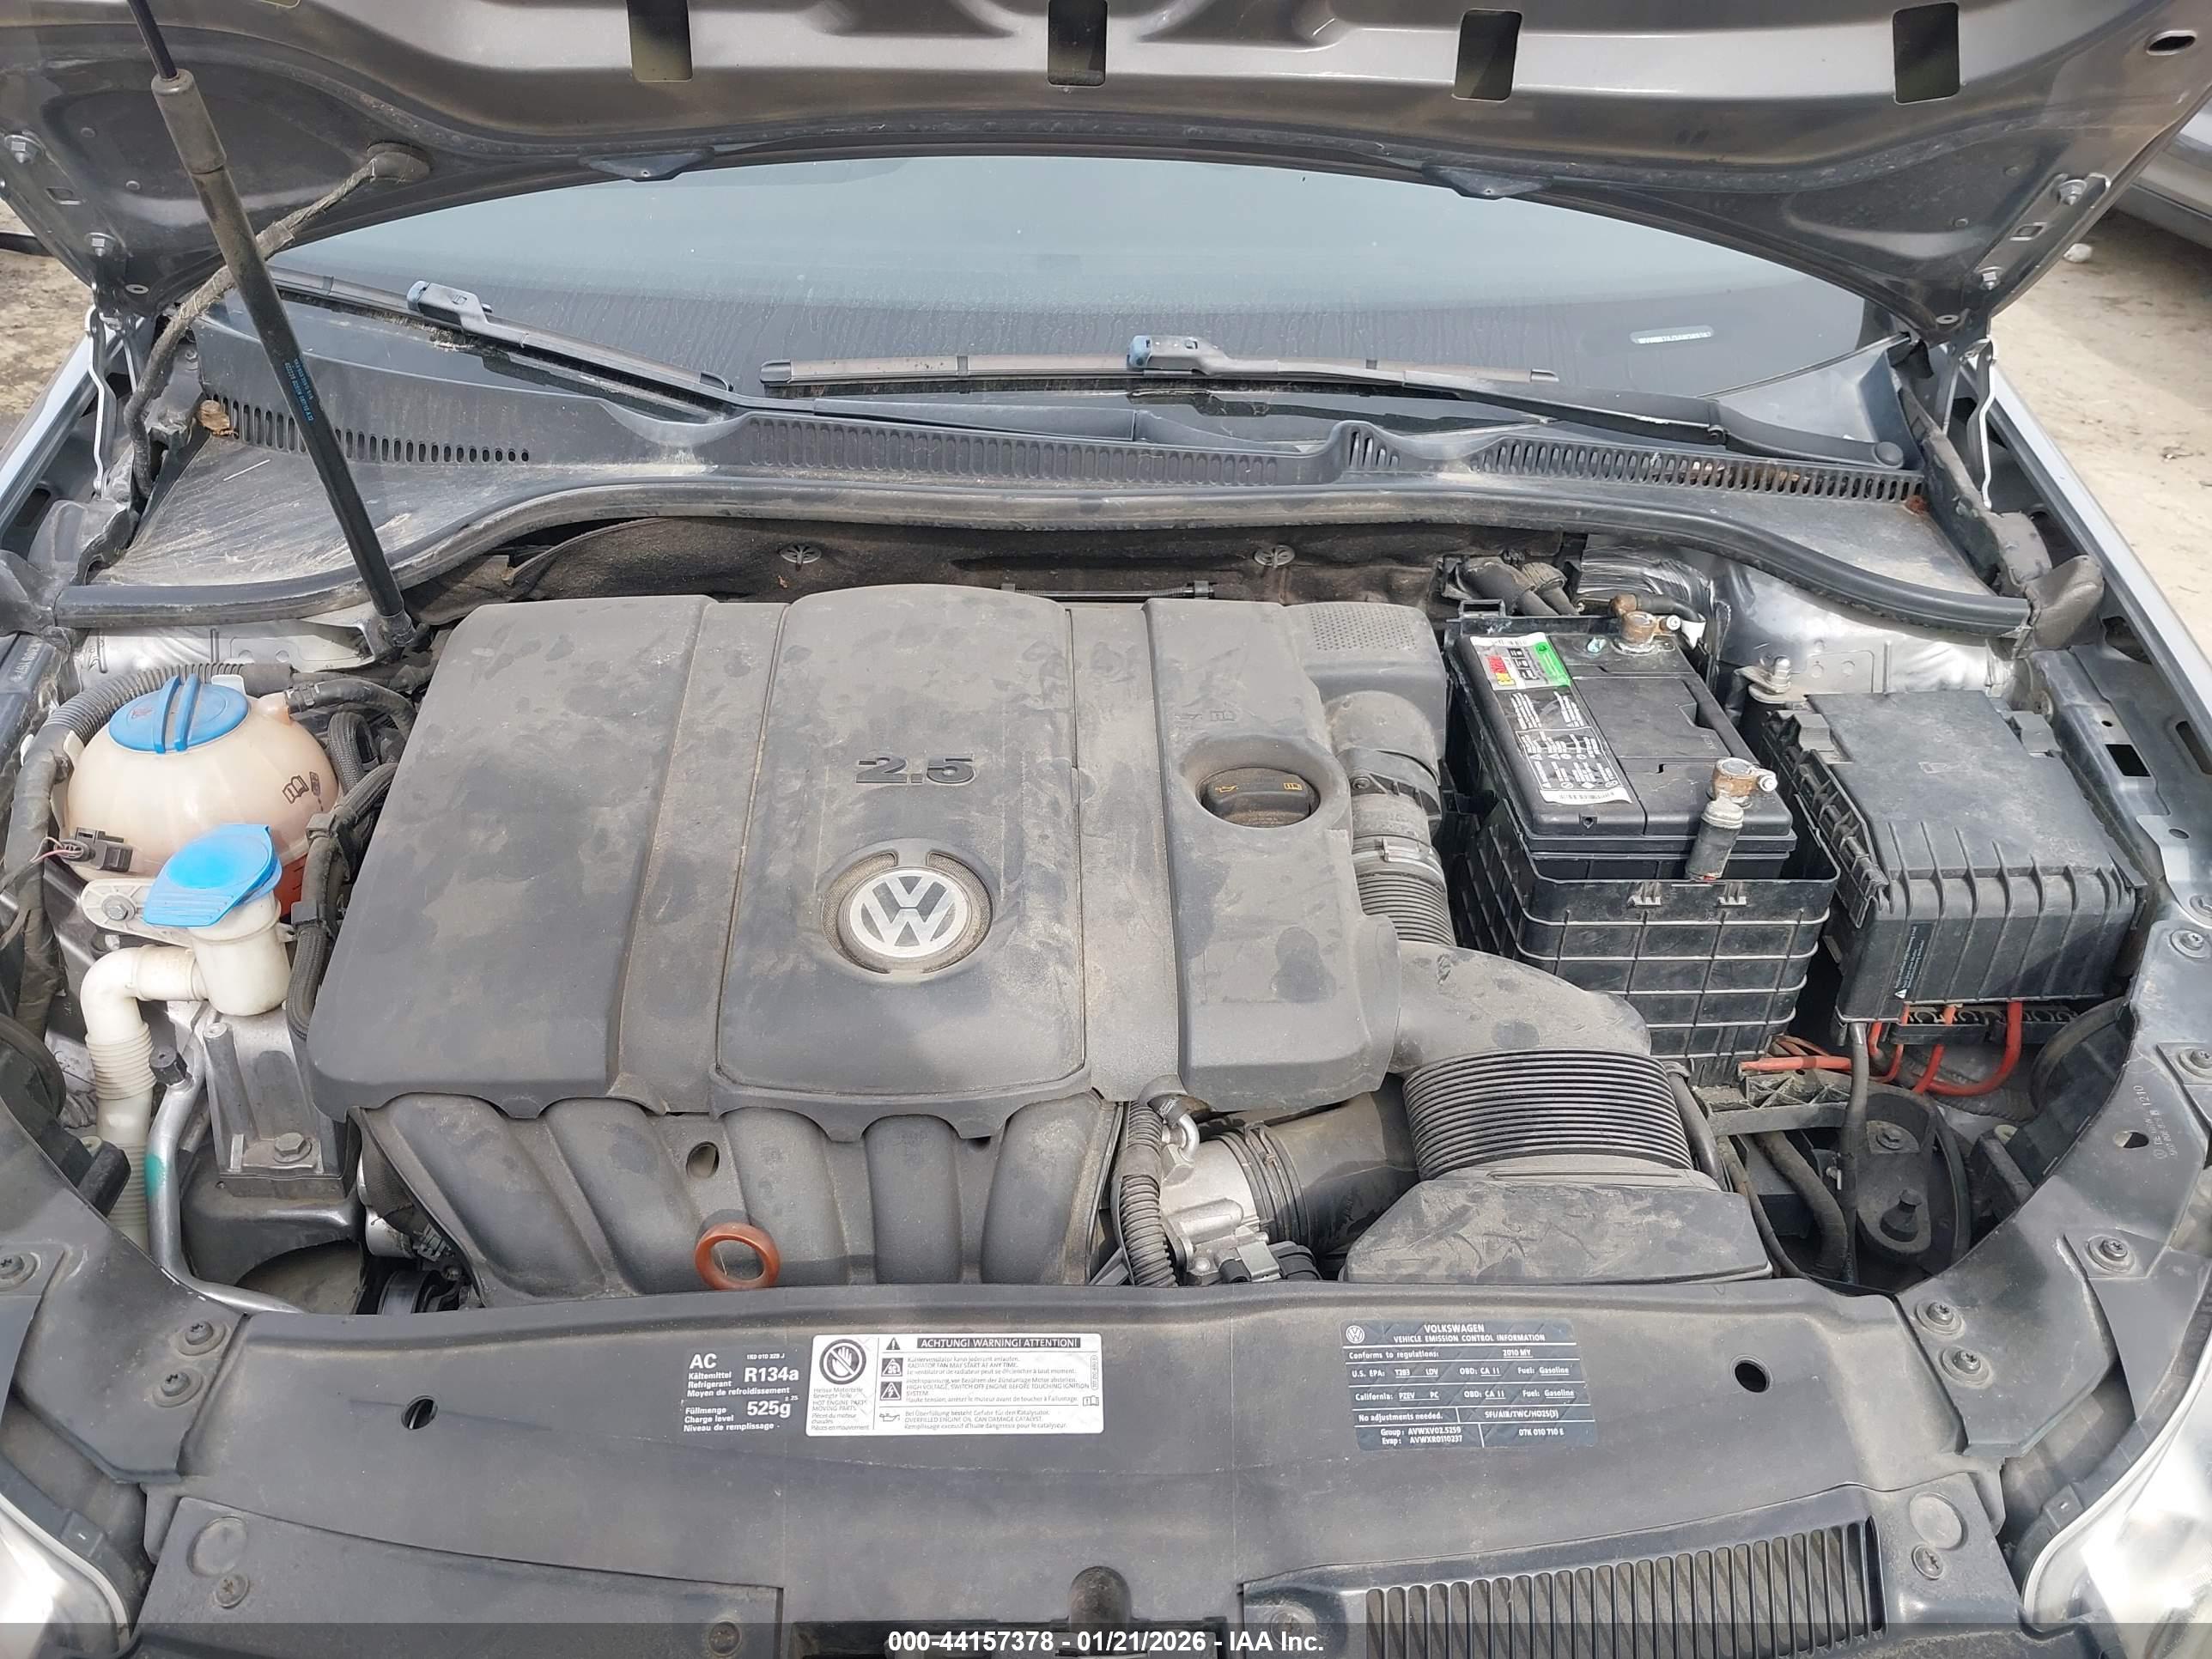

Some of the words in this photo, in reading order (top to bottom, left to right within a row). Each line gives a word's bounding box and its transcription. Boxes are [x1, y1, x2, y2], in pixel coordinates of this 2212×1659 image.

[856, 757, 975, 784] 2.5
[854, 872, 963, 954] VW
[1424, 1324, 1485, 1333] VOLKSWAGEN
[921, 1339, 970, 1348] ACHTUNG!
[972, 1339, 1021, 1347] WARNING!
[1023, 1338, 1078, 1347] ATTENTION!
[1394, 1334, 1422, 1343] VEHICLE
[1425, 1334, 1459, 1343] EMISSION
[1462, 1334, 1494, 1342] CONTROL
[1396, 1350, 1439, 1359] regulations:
[690, 1353, 718, 1369] AC
[688, 1371, 732, 1381] Kältemittel
[744, 1367, 799, 1382] R134a
[1352, 1369, 1366, 1377] U.S.
[1369, 1369, 1385, 1377] EPA:
[1539, 1365, 1570, 1374] Gasoline
[688, 1381, 732, 1389] Refrigerant
[687, 1389, 714, 1398] Moyen
[728, 1387, 790, 1395] refroidissement
[1355, 1393, 1393, 1401] California:
[1464, 1389, 1482, 1398] OBD:
[1544, 1389, 1575, 1397] Gasoline
[747, 1401, 791, 1418] 525g
[1358, 1413, 1369, 1422] No
[1370, 1412, 1414, 1423] adjustments
[1415, 1411, 1443, 1419] needed.
[684, 1424, 711, 1432] Niveau
[726, 1422, 775, 1431] remplissage
[1518, 1428, 1532, 1437] 07K
[1559, 1427, 1565, 1436] E
[1382, 1437, 1401, 1446] Evap:
